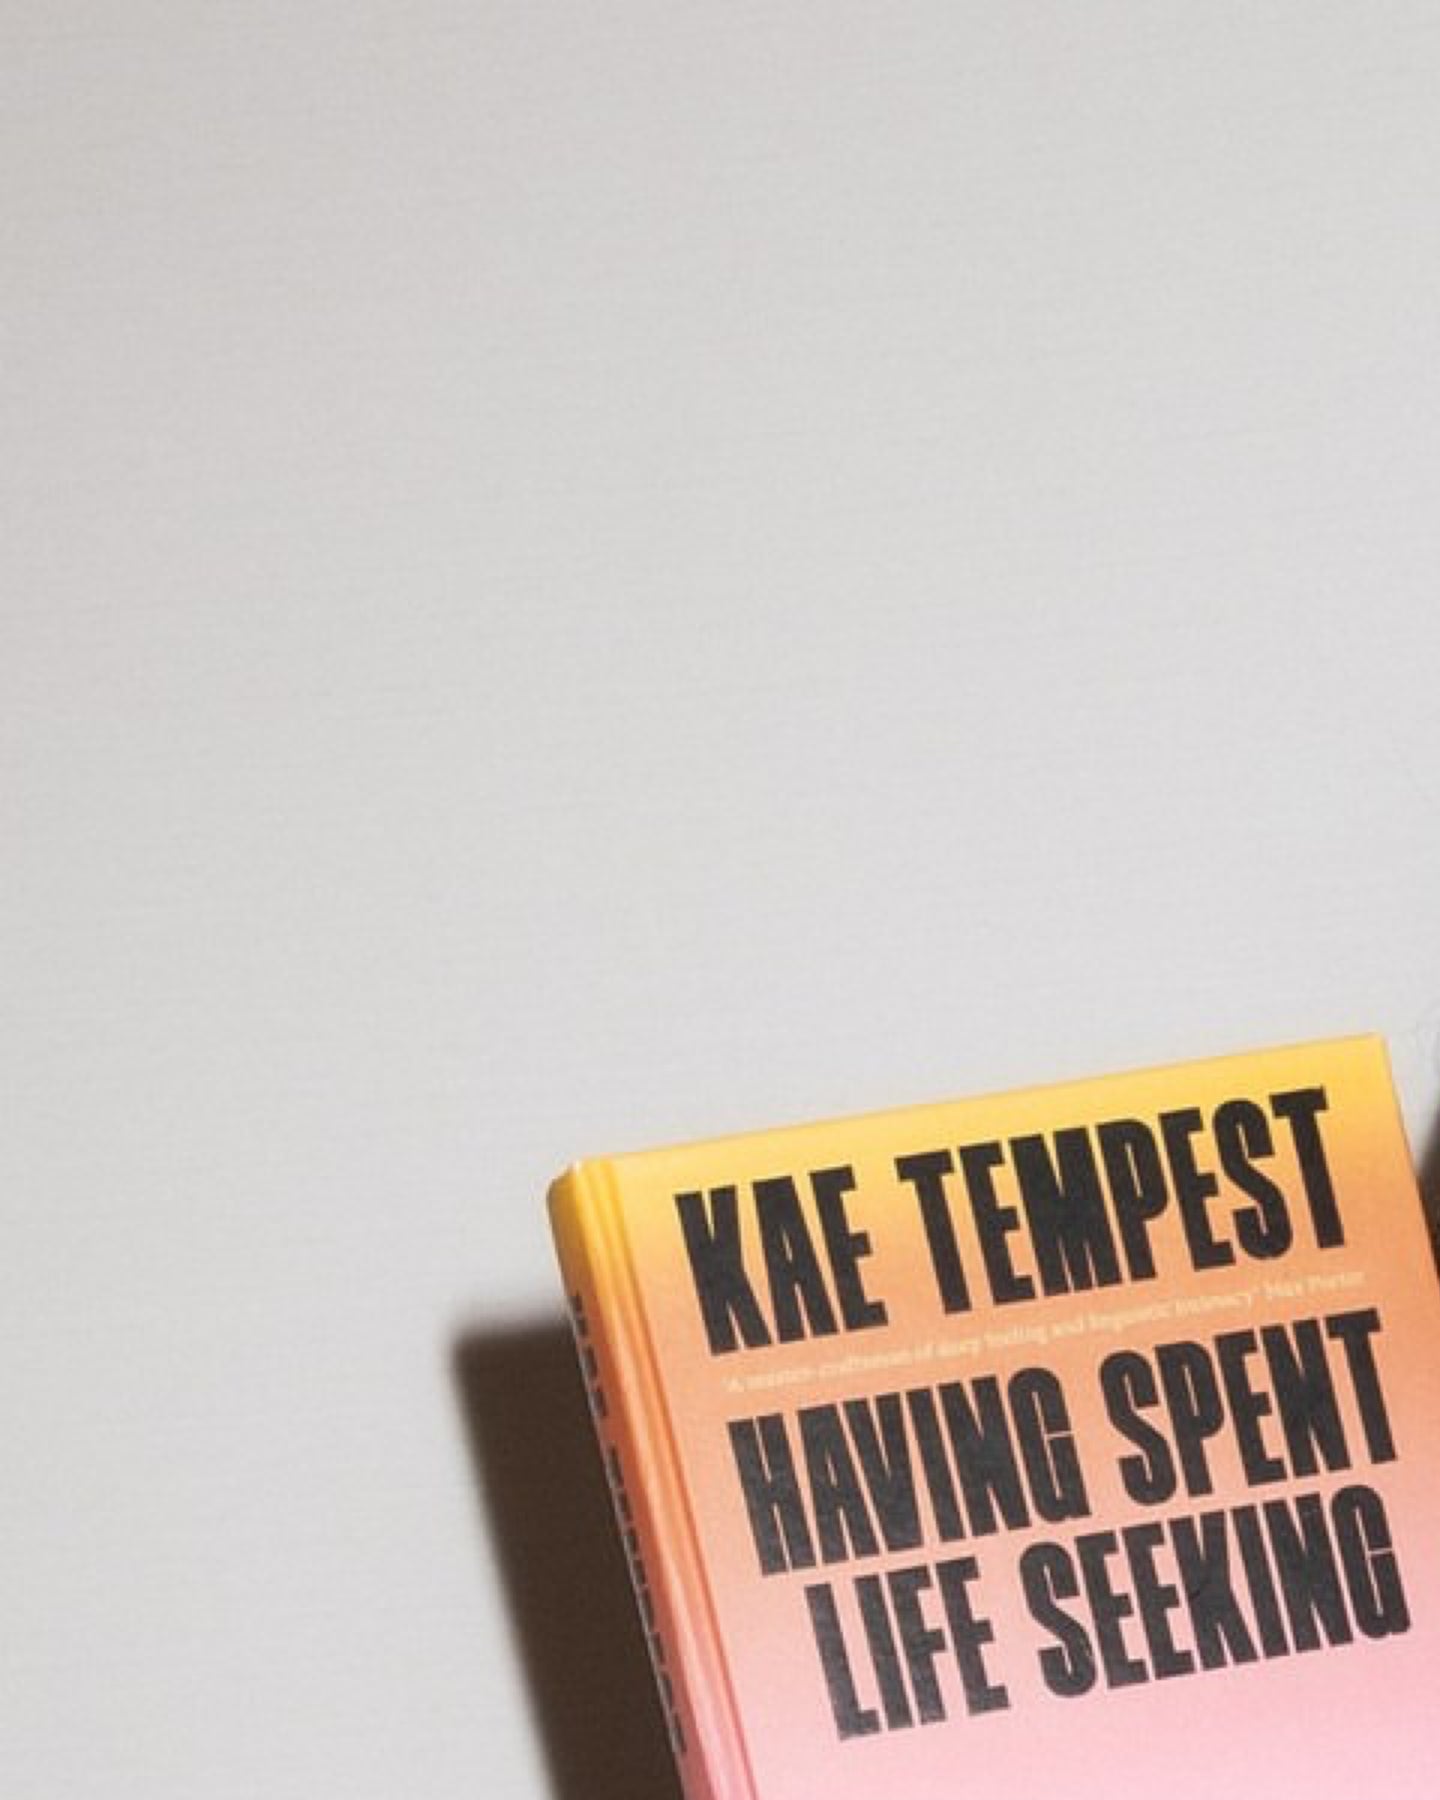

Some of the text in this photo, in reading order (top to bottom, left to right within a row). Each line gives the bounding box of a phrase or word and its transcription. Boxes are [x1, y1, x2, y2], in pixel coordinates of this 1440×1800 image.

[674, 1086, 1346, 1356] KAE TEMPEST
[726, 1366, 1092, 1576] HAVING
[1099, 1307, 1398, 1504] SPENT
[804, 1485, 1411, 1741] LIFE SEEKING
